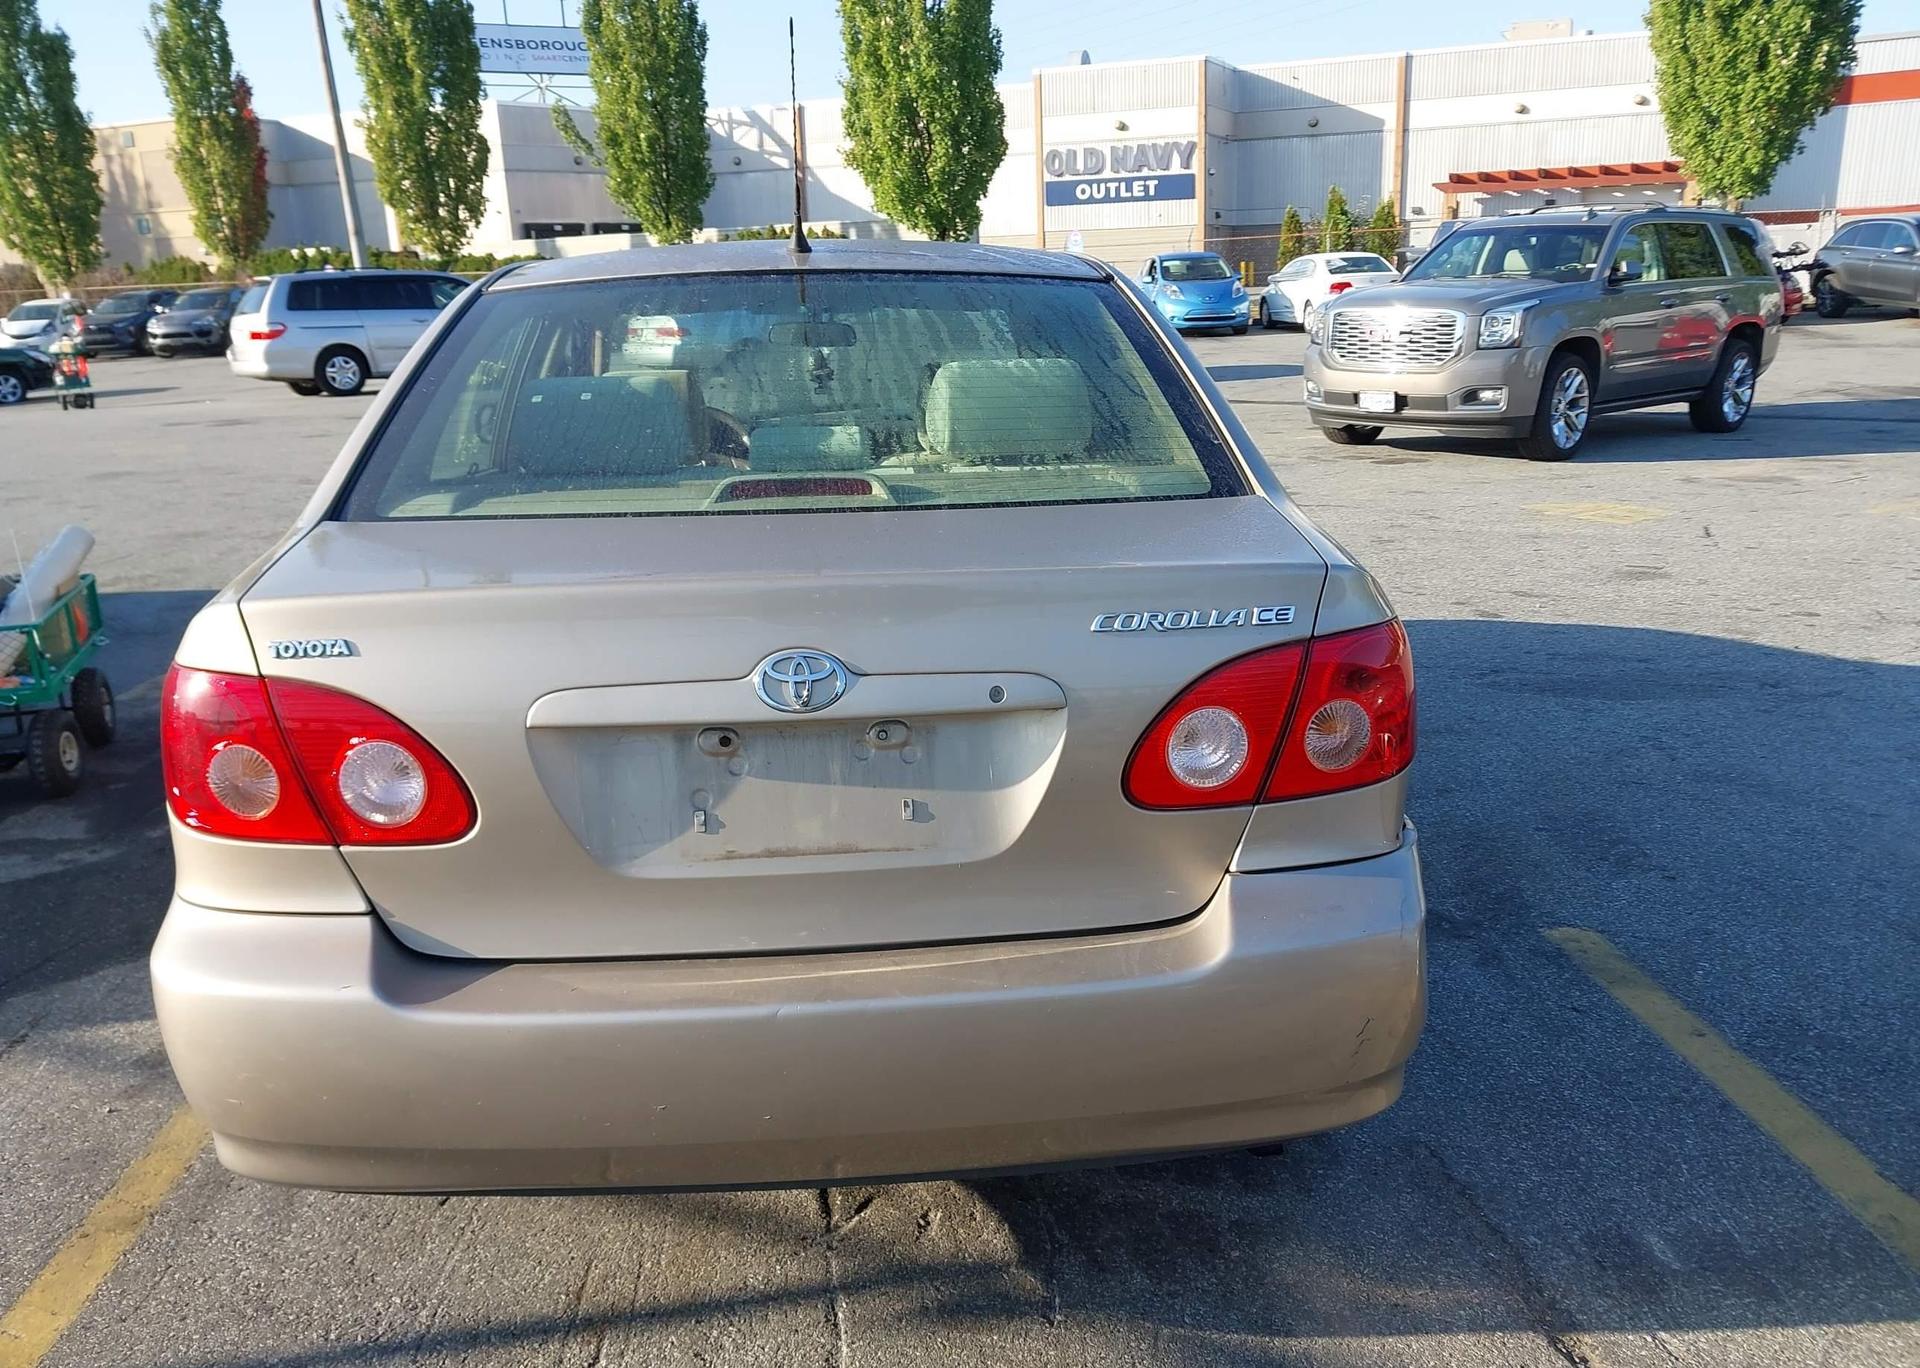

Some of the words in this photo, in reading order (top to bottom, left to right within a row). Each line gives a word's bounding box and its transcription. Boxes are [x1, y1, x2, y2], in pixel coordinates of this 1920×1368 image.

[1045, 147, 1106, 177] OLD
[1110, 141, 1197, 173] NAVY
[1075, 180, 1159, 199] OUTLET
[1090, 608, 1248, 632] COROLLA
[1254, 606, 1294, 624] CE
[269, 639, 354, 659] TOYOTA
